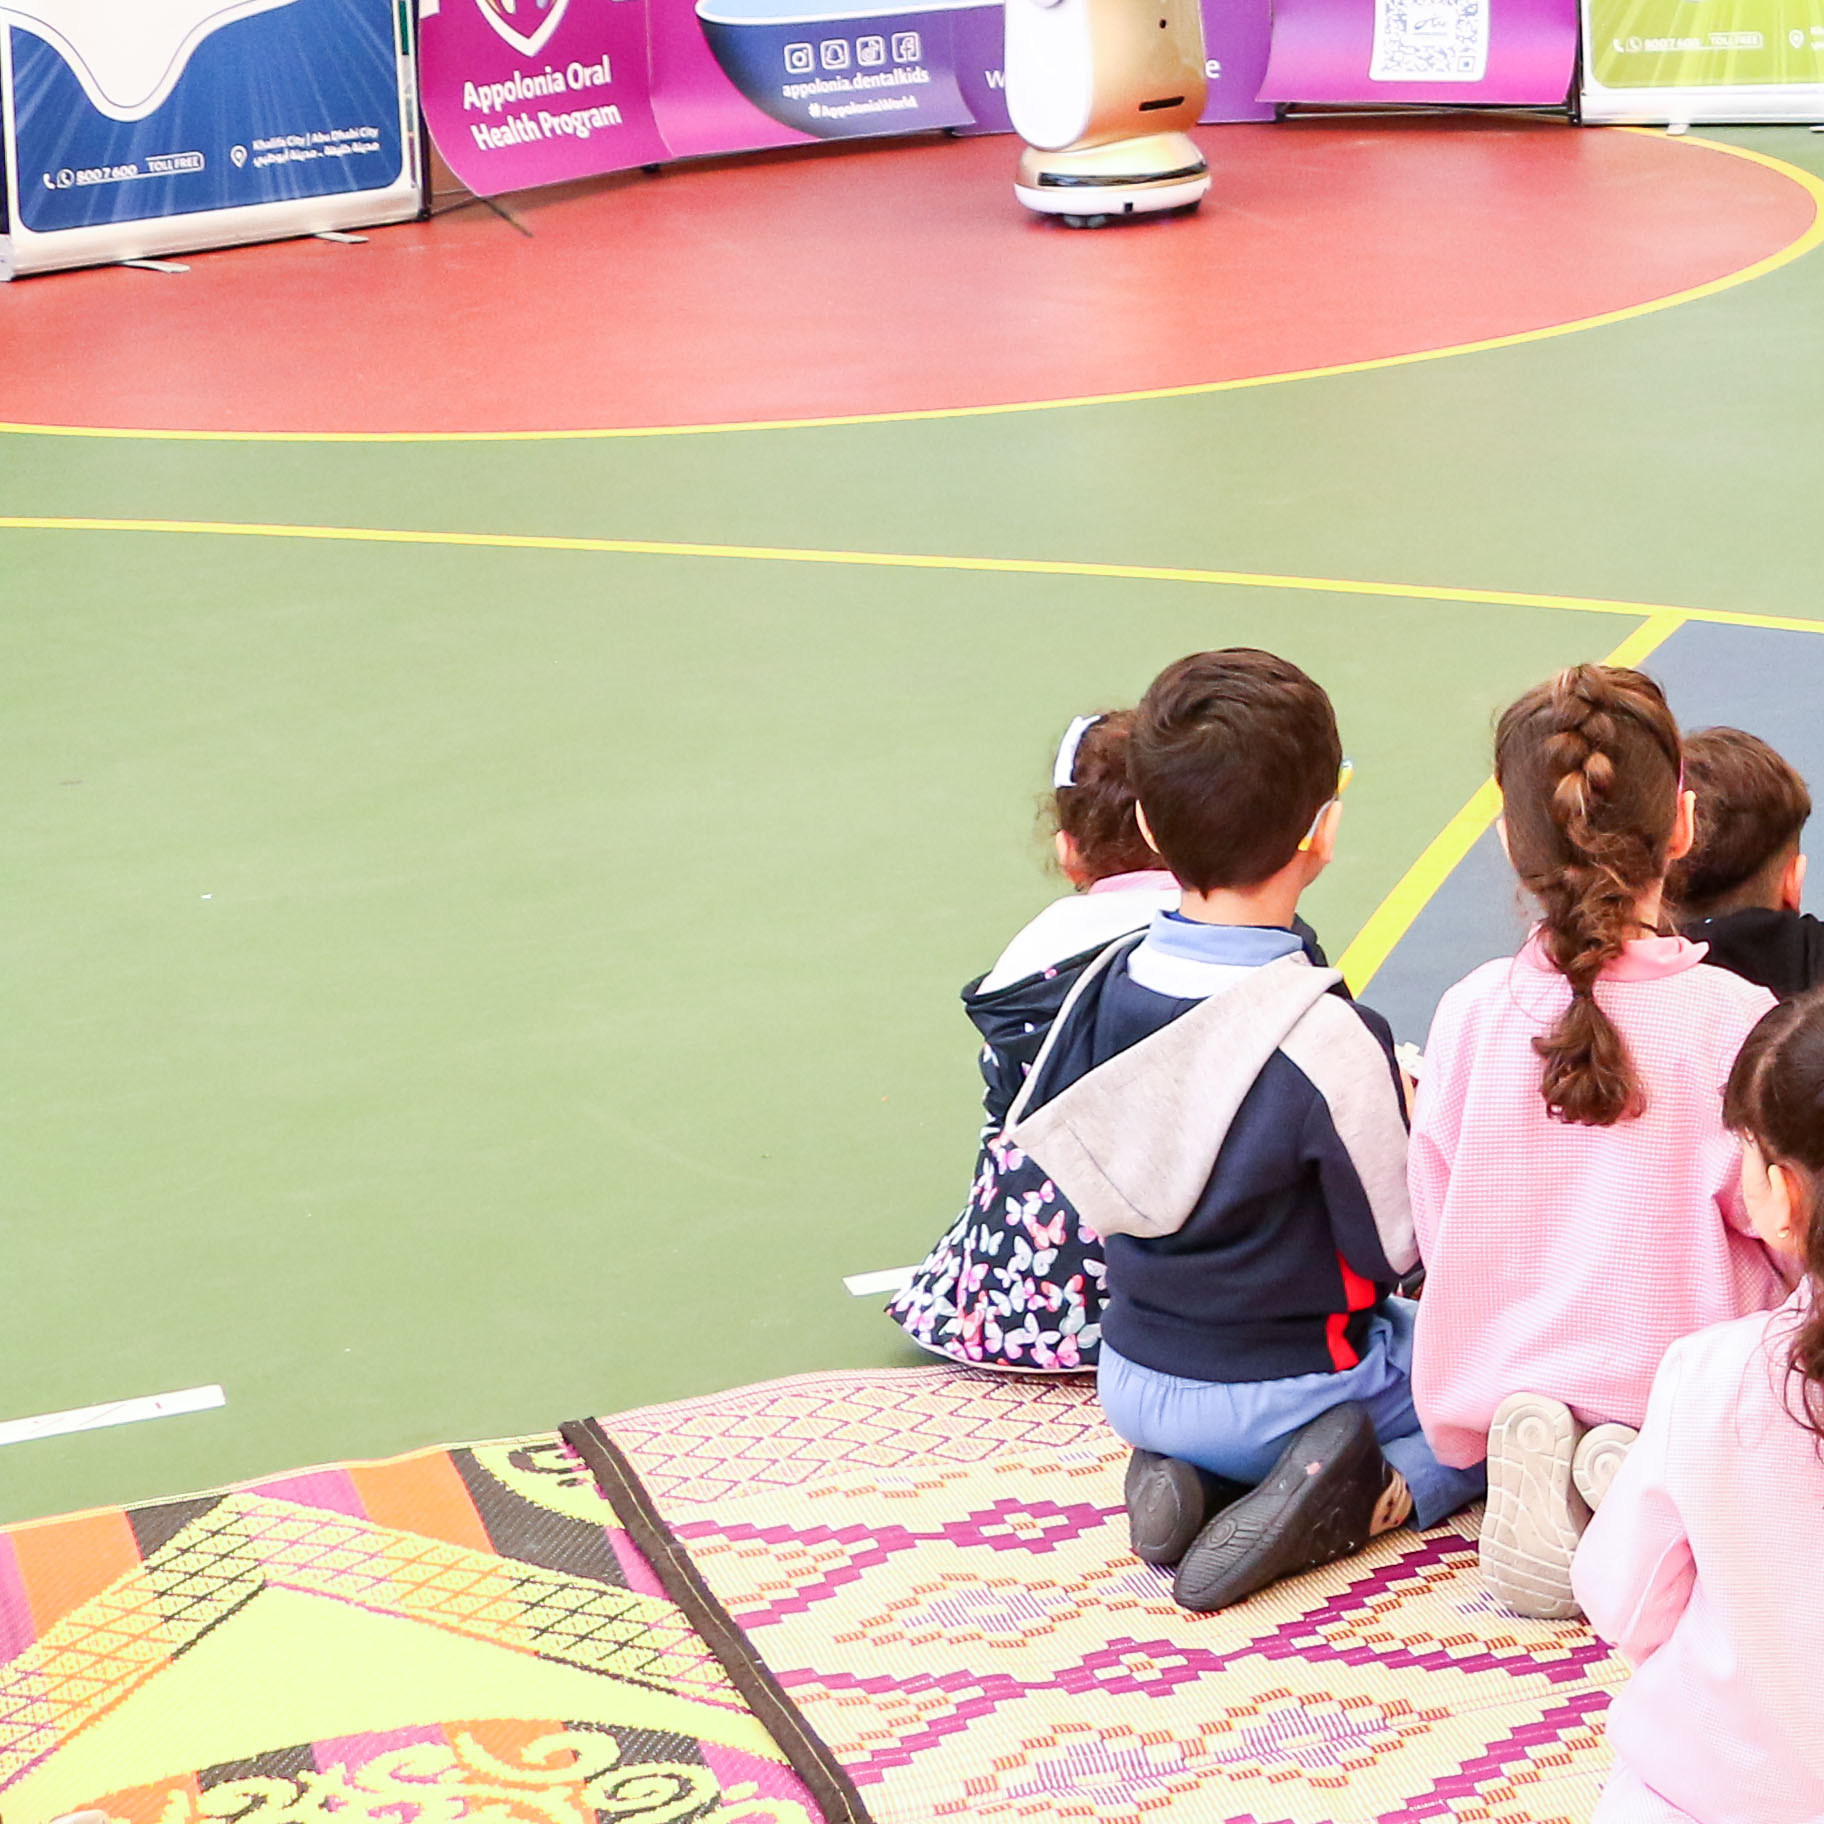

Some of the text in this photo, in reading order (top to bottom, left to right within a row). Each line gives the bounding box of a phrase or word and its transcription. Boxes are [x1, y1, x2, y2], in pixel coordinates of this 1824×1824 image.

[463, 54, 612, 114] Appolonia Oral
[782, 66, 930, 100] appolonia.dentalkids
[808, 95, 918, 118] #AppoloniaWorld
[470, 104, 623, 151] Health Program
[148, 158, 172, 172] TOLL
[174, 156, 199, 169] FREE
